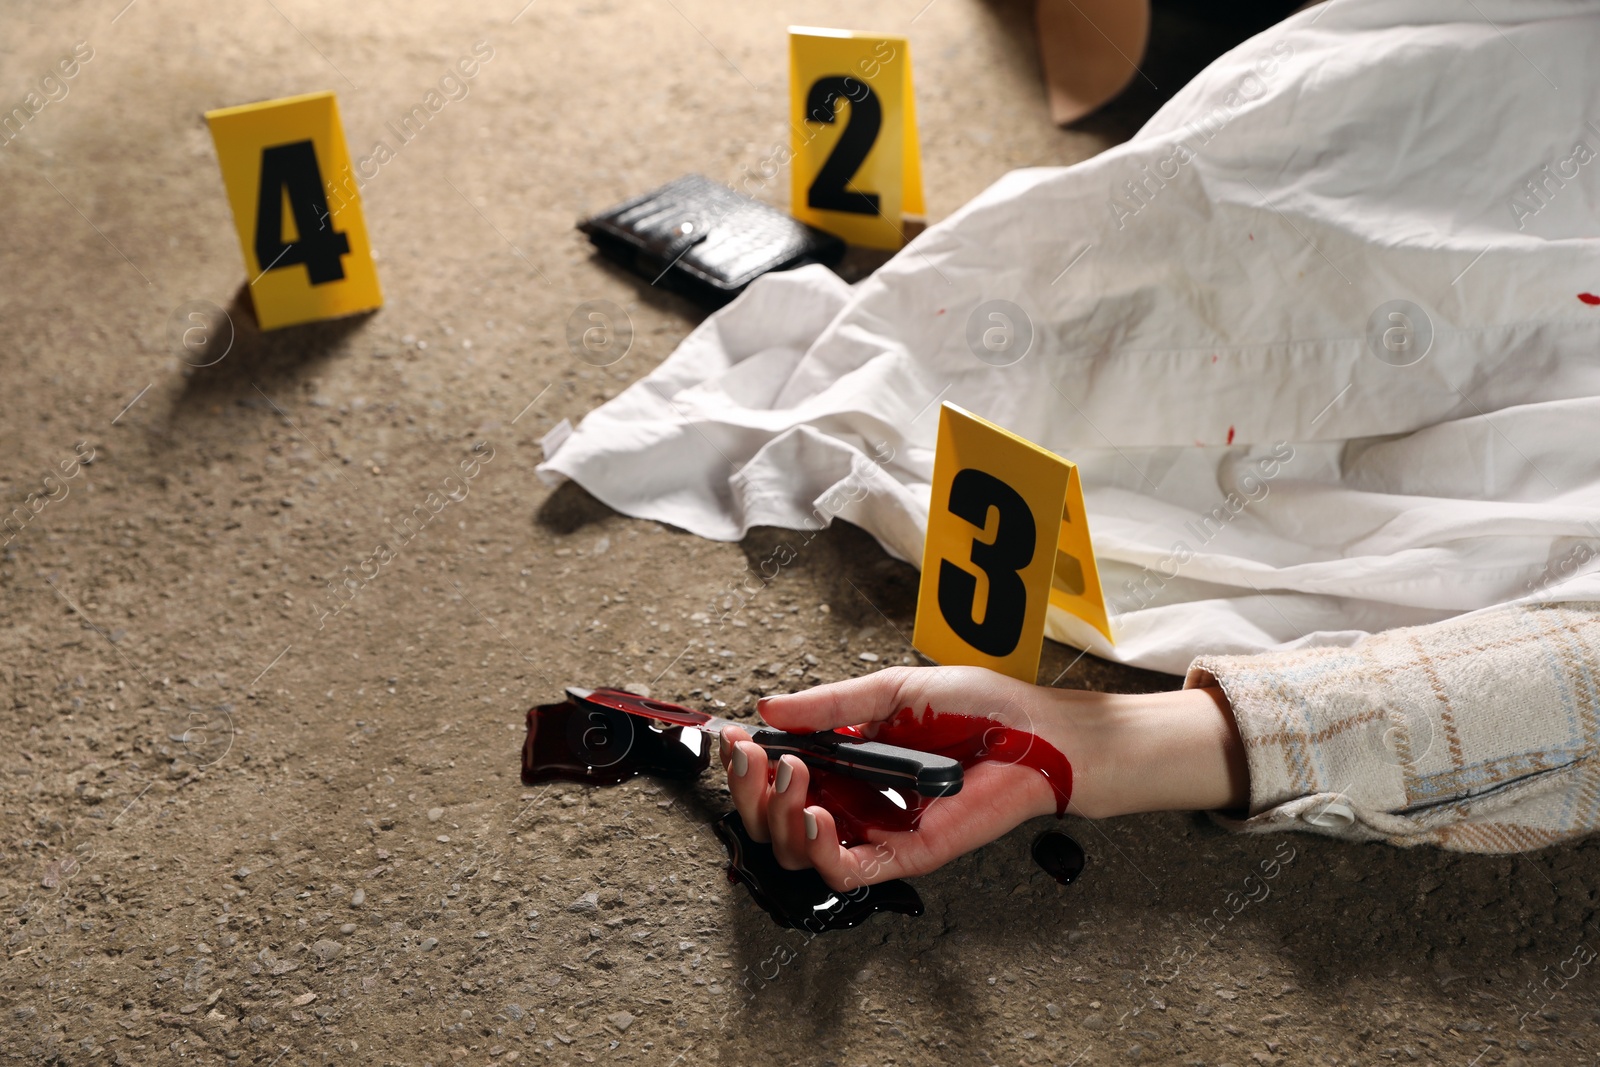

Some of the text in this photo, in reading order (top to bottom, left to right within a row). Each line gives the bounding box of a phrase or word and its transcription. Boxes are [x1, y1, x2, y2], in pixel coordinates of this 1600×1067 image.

[255, 138, 351, 287] 4
[806, 75, 882, 216] 2
[938, 468, 1036, 657] 3
